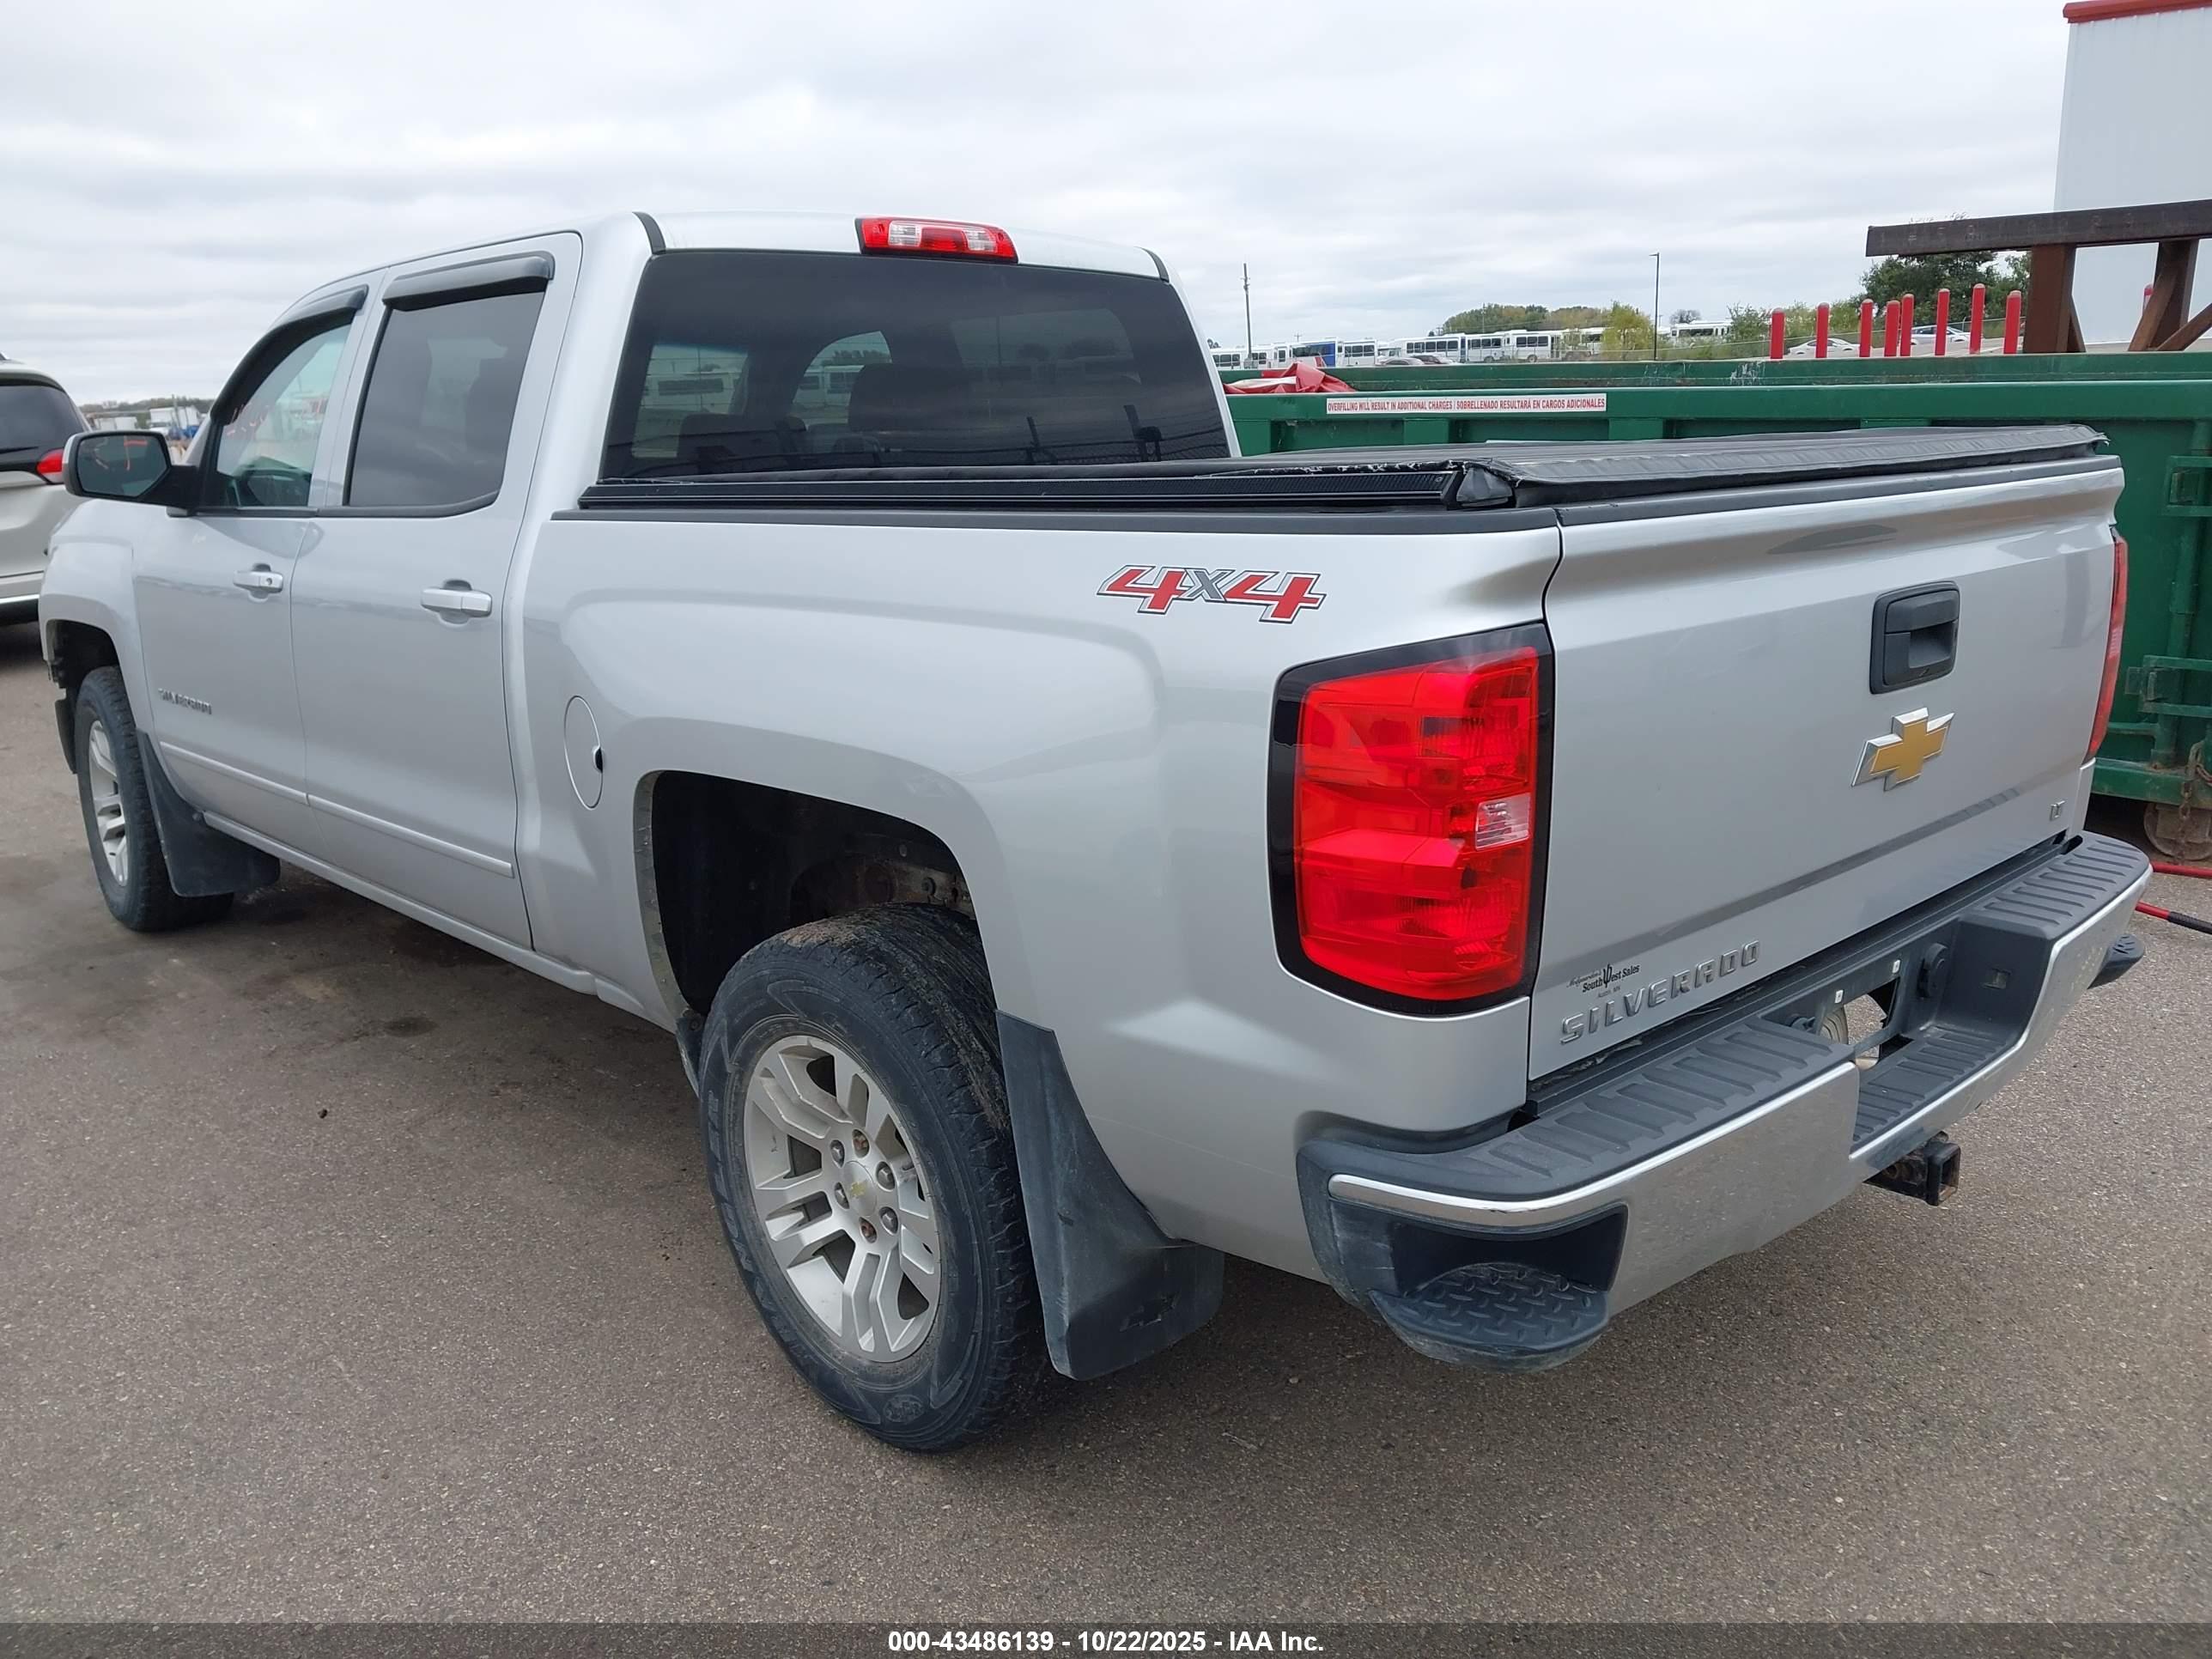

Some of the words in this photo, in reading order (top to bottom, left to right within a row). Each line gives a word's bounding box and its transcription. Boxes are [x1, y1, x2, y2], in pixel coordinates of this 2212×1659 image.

[1328, 401, 1358, 412] OVERFILLING
[1358, 401, 1370, 411] WILL
[1371, 401, 1389, 411] RESULT
[1391, 401, 1396, 410] IN
[1397, 400, 1426, 410] ADDITIONAL
[1428, 400, 1453, 410] CHARGES
[1456, 399, 1498, 410] SOBRELLENADO
[1499, 398, 1531, 410] RESULTARÁ
[1533, 399, 1540, 409] EN
[1541, 398, 1565, 410] CARGOS
[1566, 398, 1605, 409] ADICIONALES
[1559, 939, 1759, 1046] SILVERADO
